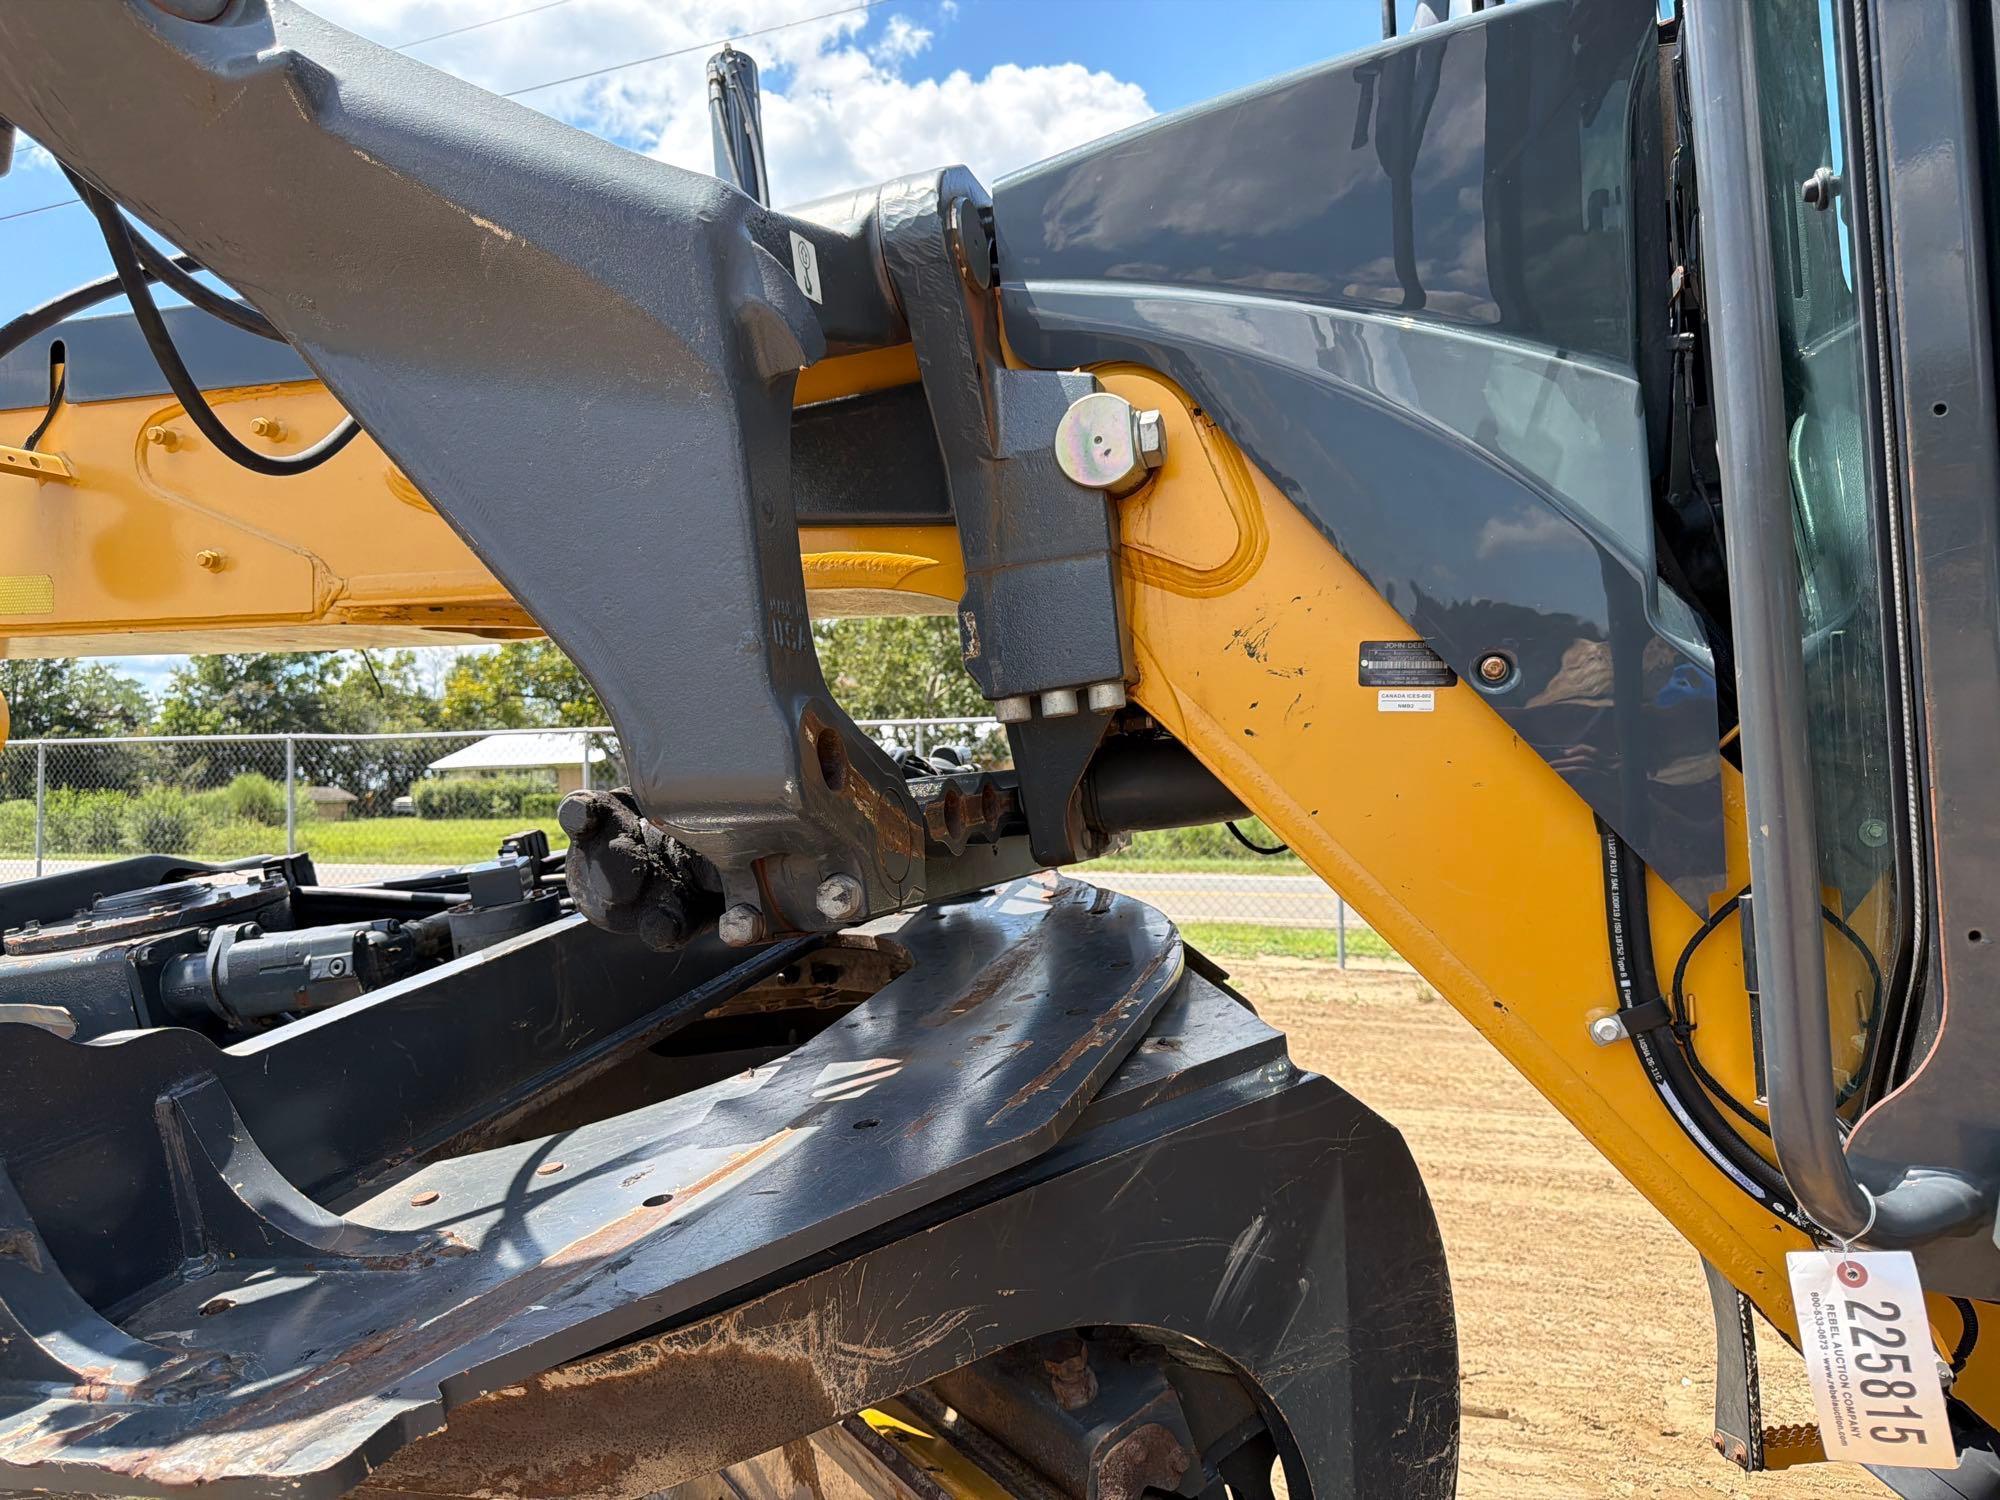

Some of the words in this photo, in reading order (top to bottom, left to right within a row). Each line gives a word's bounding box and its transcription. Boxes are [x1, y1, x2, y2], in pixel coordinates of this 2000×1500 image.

[1609, 860, 1618, 873] R19
[1611, 878, 1619, 890] SAE
[1612, 892, 1621, 917] 100R19
[1614, 922, 1623, 934] ISO
[1615, 935, 1625, 956] 18752
[1616, 956, 1627, 973] Type
[1638, 1038, 1651, 1058] MSHA
[1824, 1303, 1840, 1339] REBEL
[1832, 1341, 1849, 1389] AUCTION
[1842, 1391, 1862, 1439] COMPANY
[1844, 1299, 1928, 1445] 225815
[1823, 1356, 1849, 1447] www.rebelauction.com
